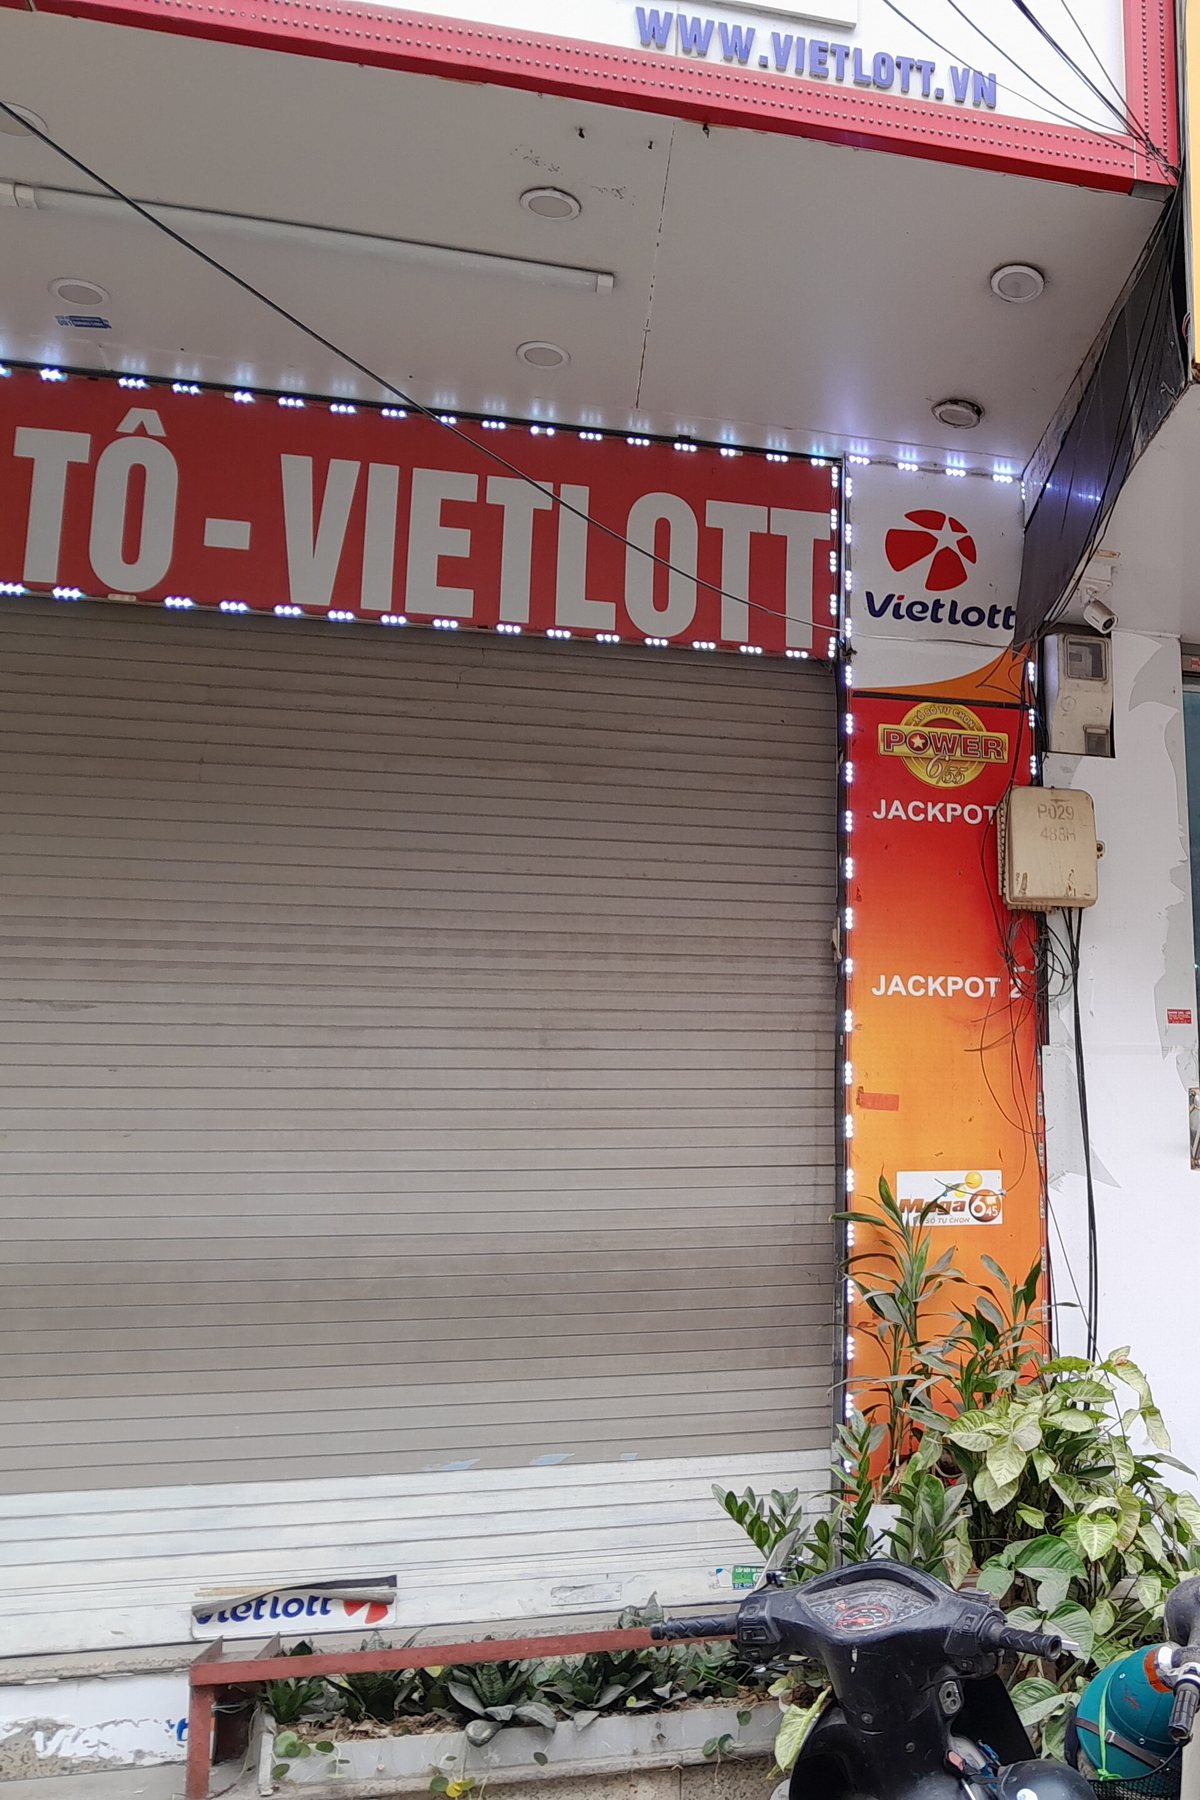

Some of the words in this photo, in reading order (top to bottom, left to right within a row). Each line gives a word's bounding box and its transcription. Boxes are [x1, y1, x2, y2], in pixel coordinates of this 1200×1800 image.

[635, 6, 998, 109] WWW.VIETLOTT.VN
[13, 408, 179, 593] TÔ
[280, 453, 831, 649] VIETLOTT
[866, 591, 1015, 631] Vietlott
[884, 728, 1005, 760] POWER
[872, 799, 997, 825] JACKPOT
[1037, 804, 1075, 820] P029
[871, 974, 1000, 998] JACKPOT
[1008, 978, 1023, 998] 2
